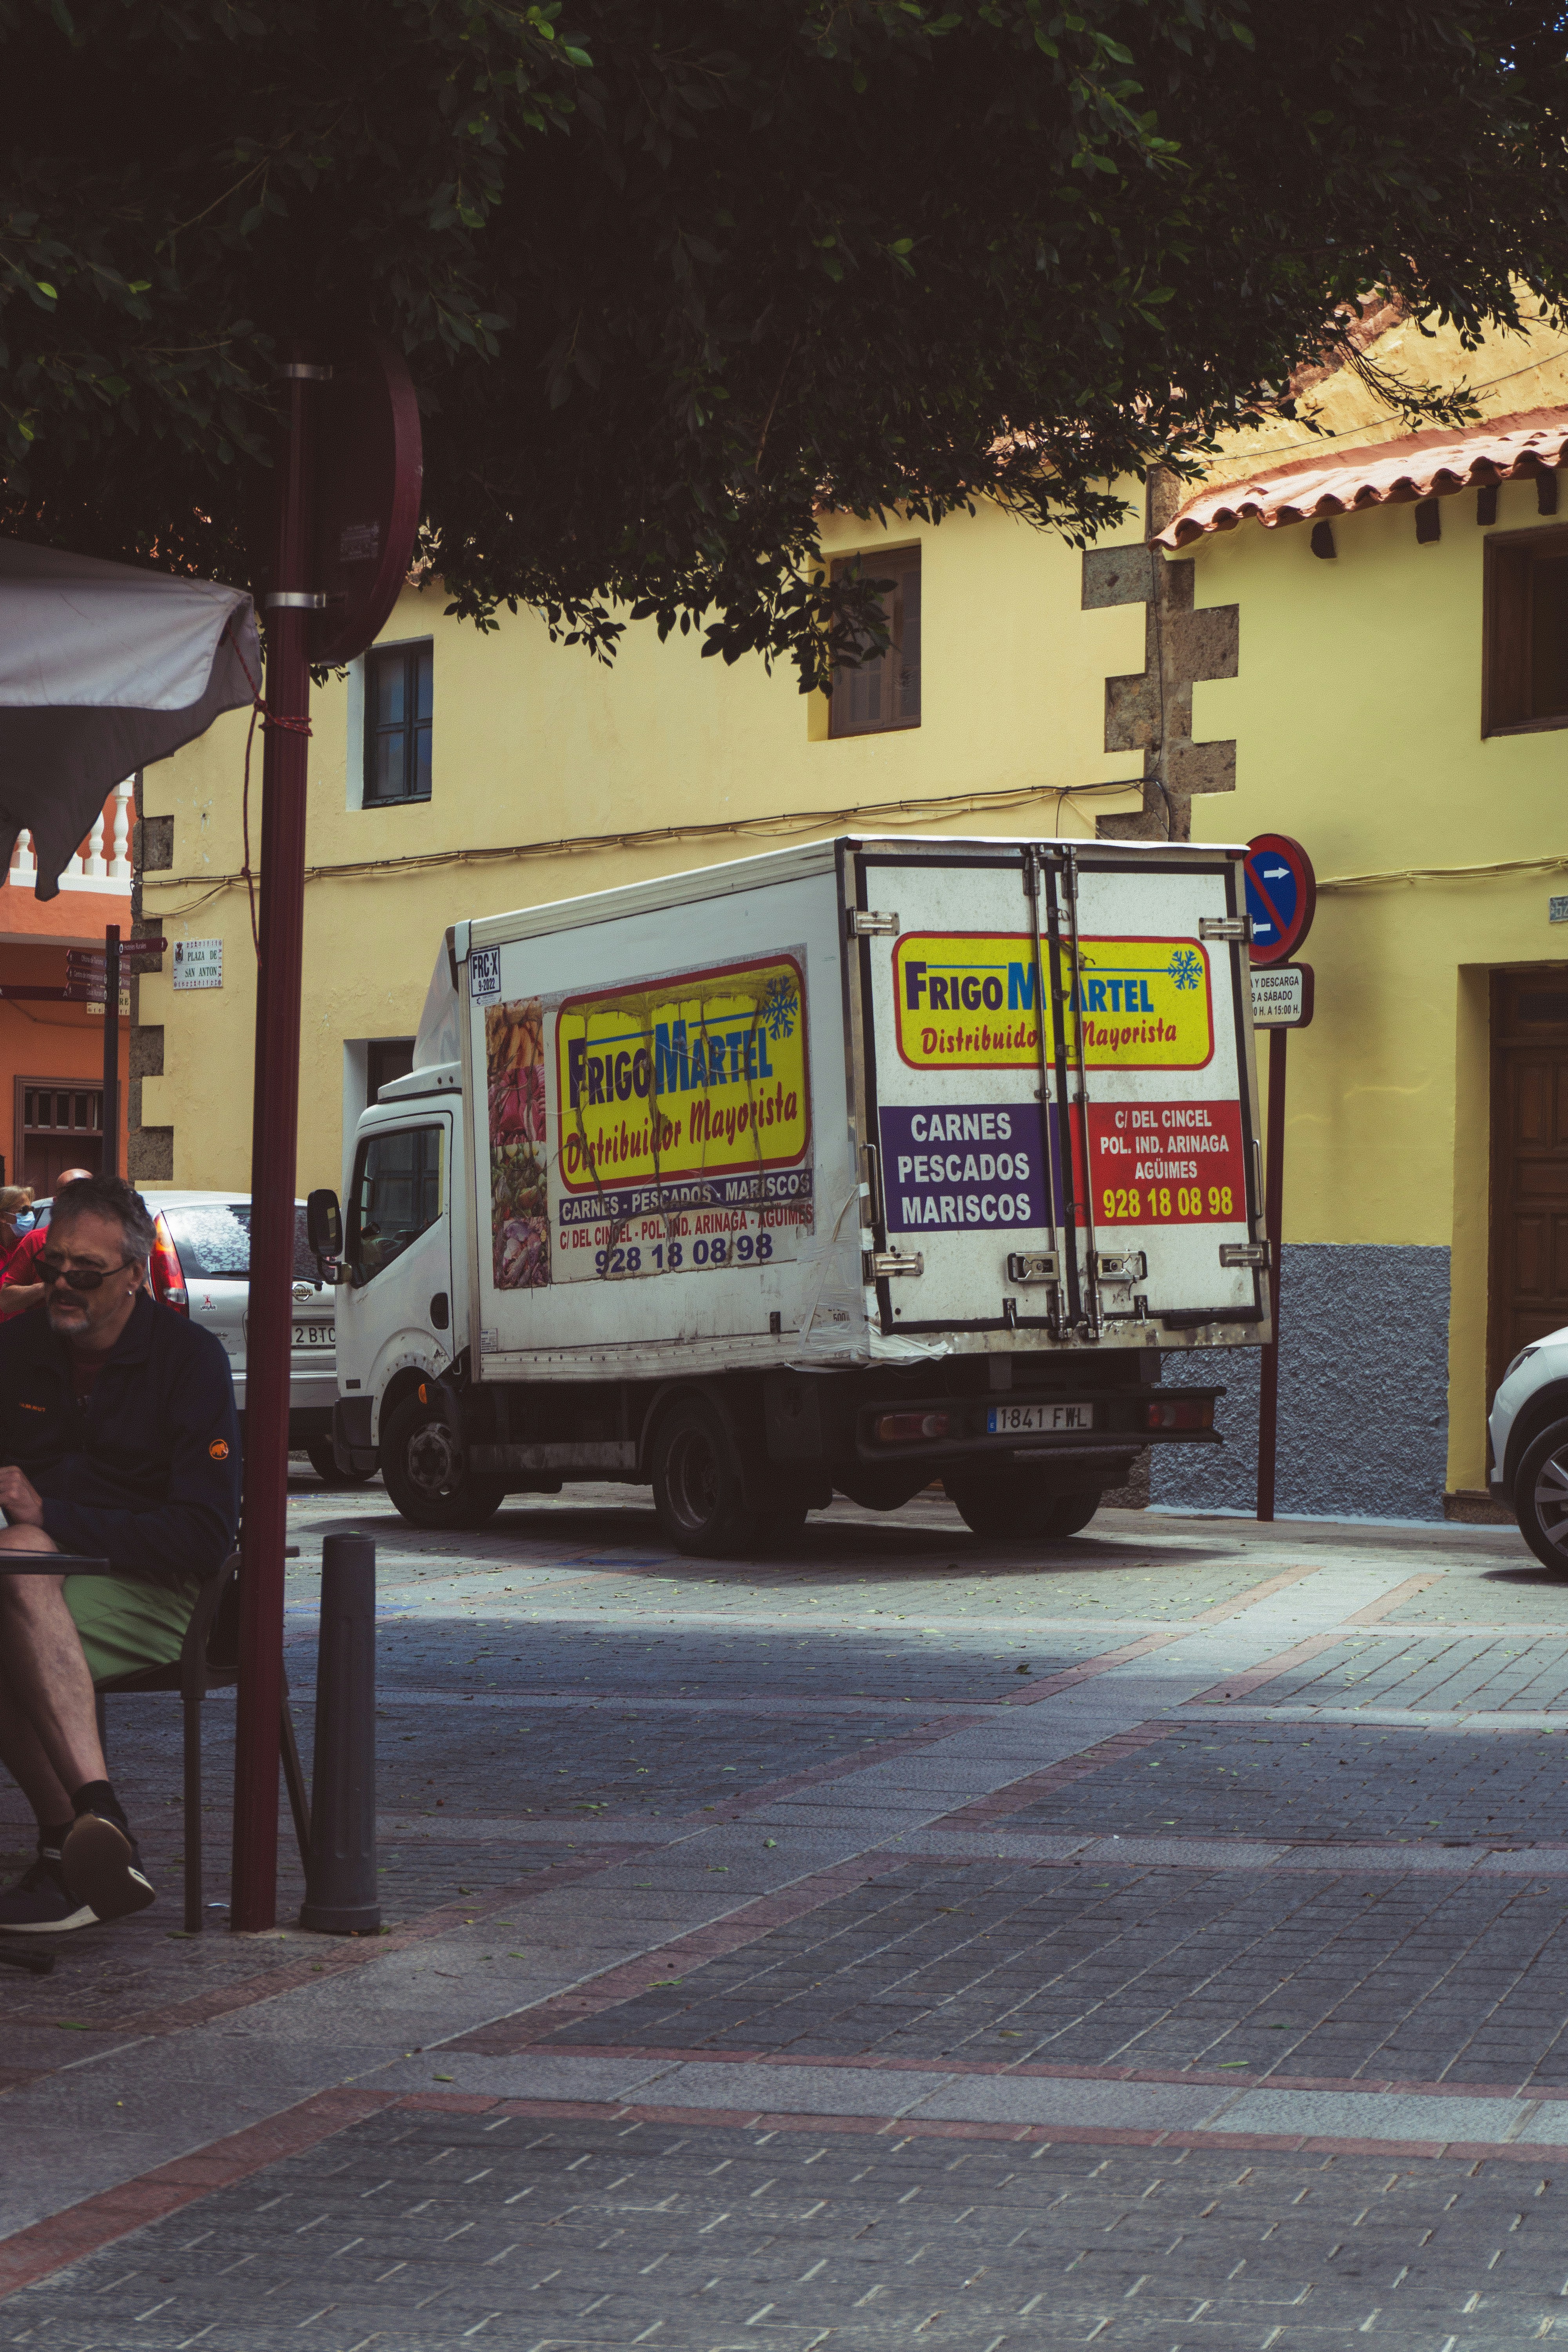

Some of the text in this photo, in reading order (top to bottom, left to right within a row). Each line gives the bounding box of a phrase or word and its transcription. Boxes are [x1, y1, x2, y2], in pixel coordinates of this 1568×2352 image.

[188, 950, 218, 962] PLAZA DE
[185, 966, 217, 978] SAN ANTON
[1255, 978, 1259, 987] Y
[1261, 976, 1299, 987] DESCARGA
[478, 978, 495, 992] 9-2022
[1257, 992, 1262, 1002] A
[1264, 990, 1292, 1002] SÁBADO
[1267, 1006, 1272, 1016] A
[1274, 1005, 1291, 1015] 15:00
[1293, 1004, 1300, 1014] H.
[921, 1022, 1045, 1054] Distribuido
[690, 1081, 797, 1146] Mayorista
[1115, 1110, 1212, 1129] C/ DEL CINCEL
[911, 1112, 1012, 1142] CARNES
[1100, 1135, 1229, 1154] POL. IND. ARINAGA
[898, 1153, 1030, 1183] PESCADOS
[1135, 1158, 1198, 1179] AGÜIMES
[562, 1196, 619, 1221] CARNES
[632, 1185, 711, 1212] PESCADOS
[726, 1173, 810, 1201] MARISCOS
[1103, 1186, 1233, 1218] 928 18 08 98
[902, 1193, 1031, 1224] MARISCOS
[559, 1230, 570, 1250] C/
[572, 1228, 592, 1249] DEL
[641, 1220, 666, 1240] POL.
[695, 1210, 748, 1235] ARINAGA
[595, 1233, 773, 1274] 928 18 08 98
[1001, 1407, 1087, 1429] 1841 FWL
